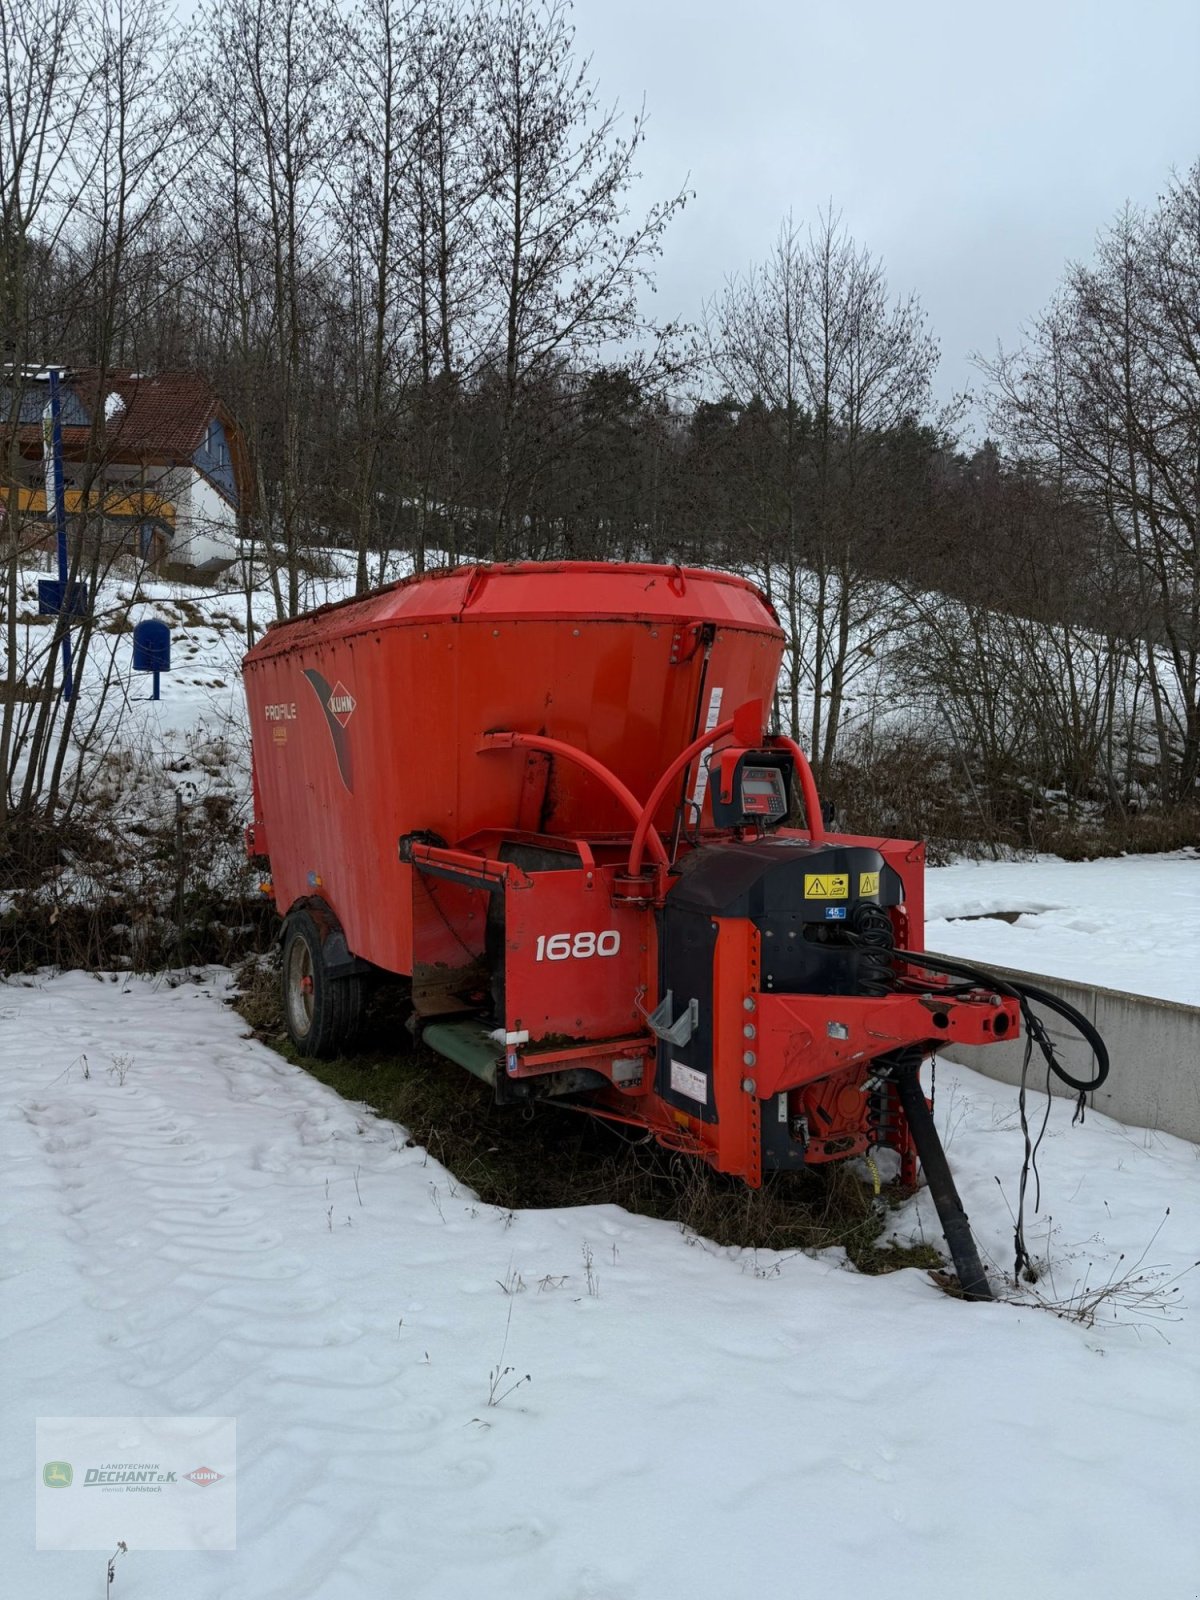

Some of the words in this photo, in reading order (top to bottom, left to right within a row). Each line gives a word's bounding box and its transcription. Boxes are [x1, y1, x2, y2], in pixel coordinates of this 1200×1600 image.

[265, 703, 296, 720] PROFILE
[330, 696, 352, 713] KUHN
[536, 930, 620, 961] 1680
